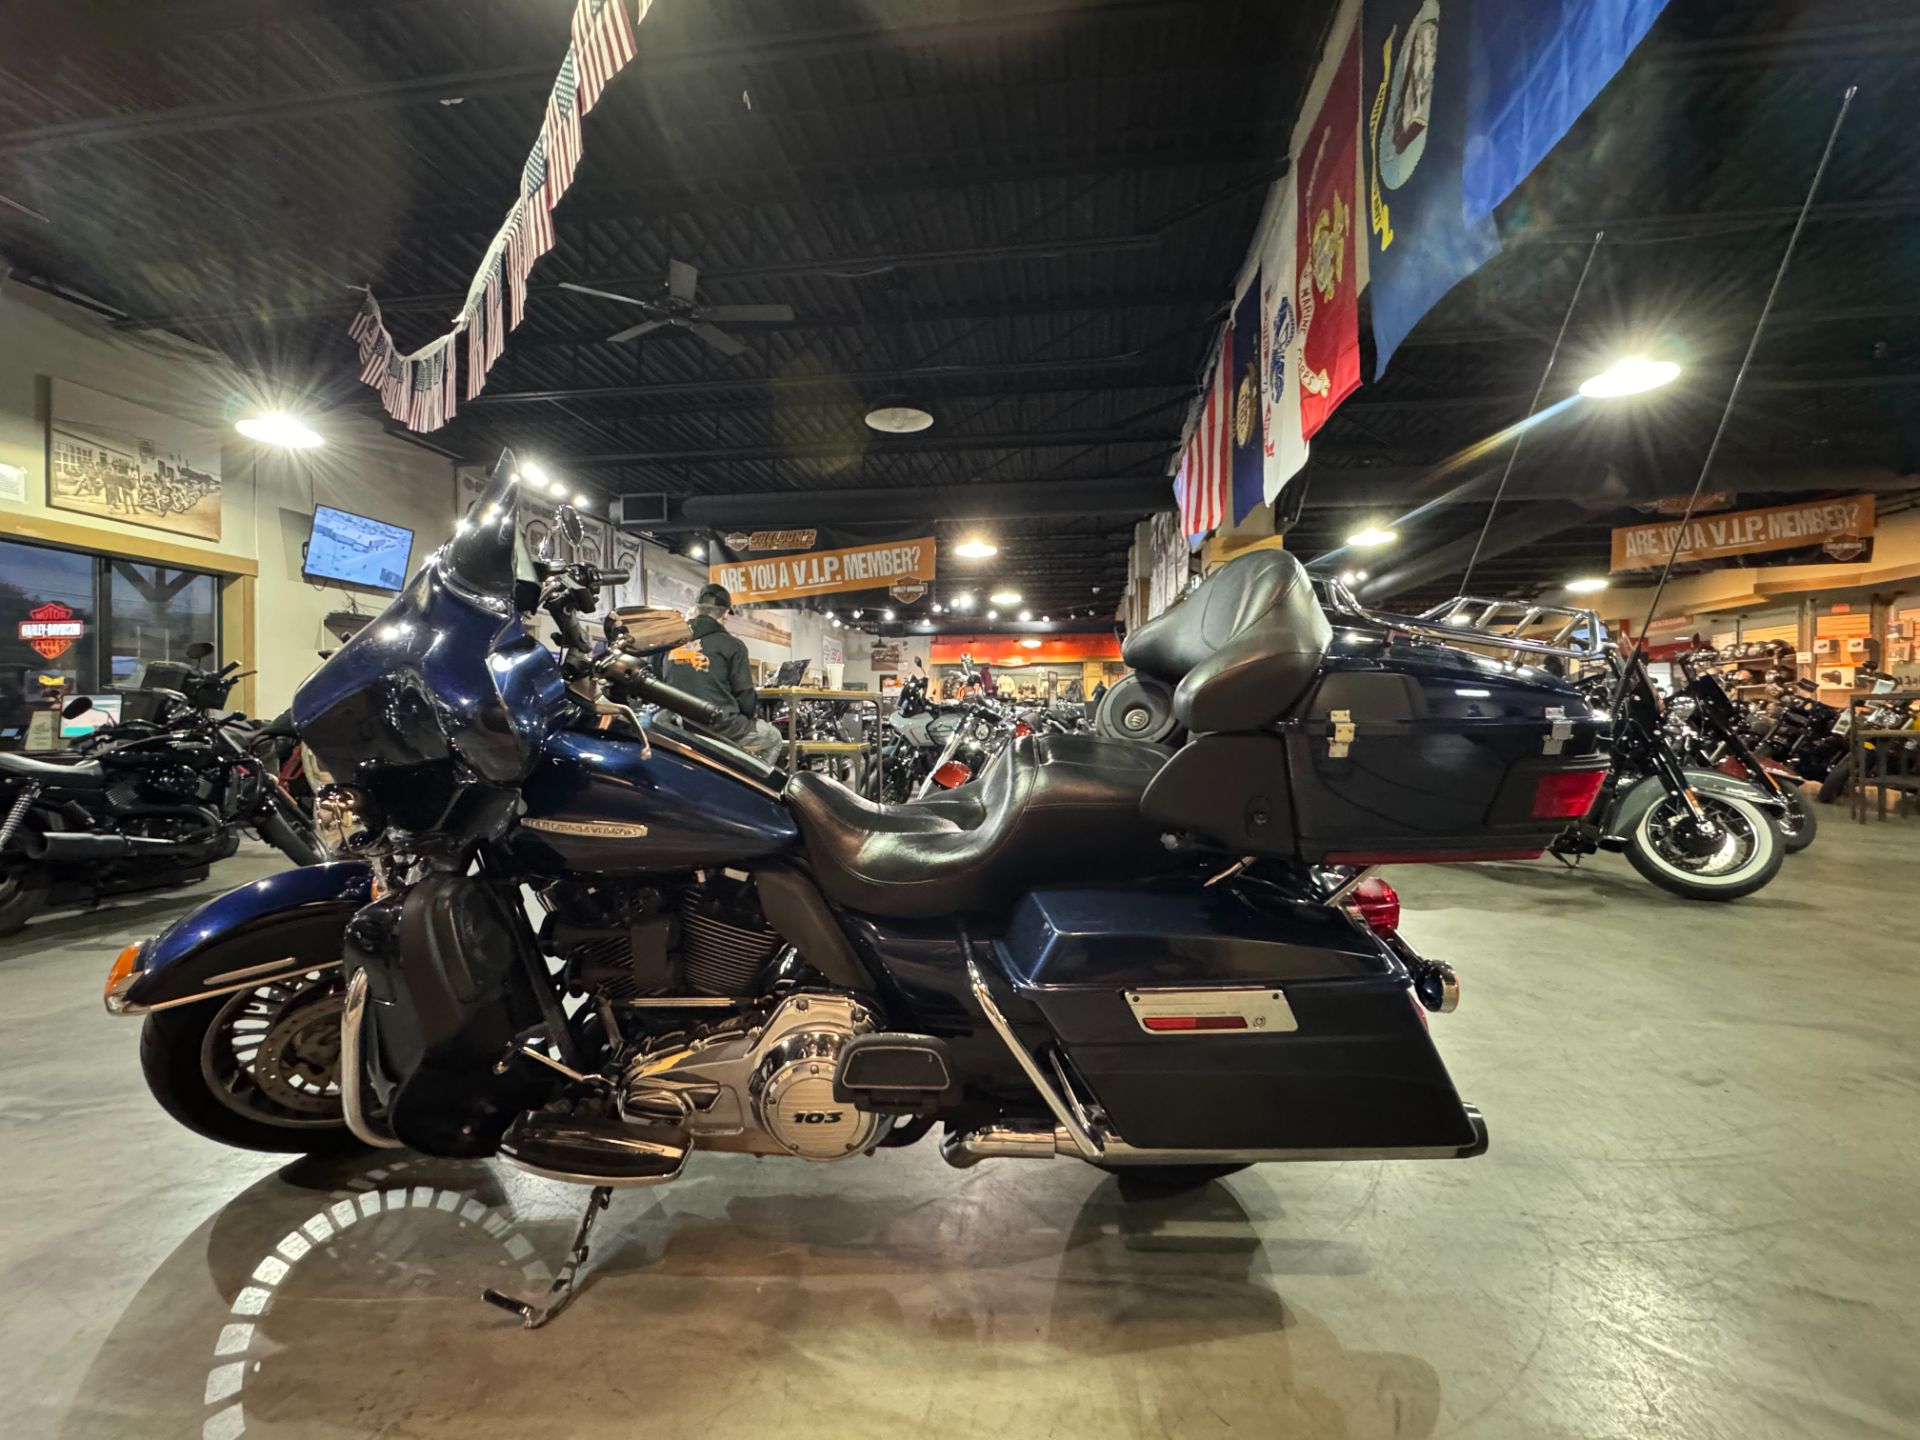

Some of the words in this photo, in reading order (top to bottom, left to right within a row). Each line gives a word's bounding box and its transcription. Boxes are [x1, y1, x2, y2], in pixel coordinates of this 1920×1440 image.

[1301, 288, 1313, 334] MARINE
[1626, 528, 1658, 558] ARE
[1662, 524, 1693, 551] YOU
[1694, 524, 1707, 548] A
[1709, 517, 1765, 546] V.I.P.
[1769, 504, 1858, 539] MEMBER?
[720, 567, 748, 594] ARE
[750, 562, 777, 592] YOU
[779, 562, 790, 588] A
[792, 556, 842, 586] V.I.P.
[845, 545, 921, 580] MEMBER?
[794, 1110, 843, 1124] 103
